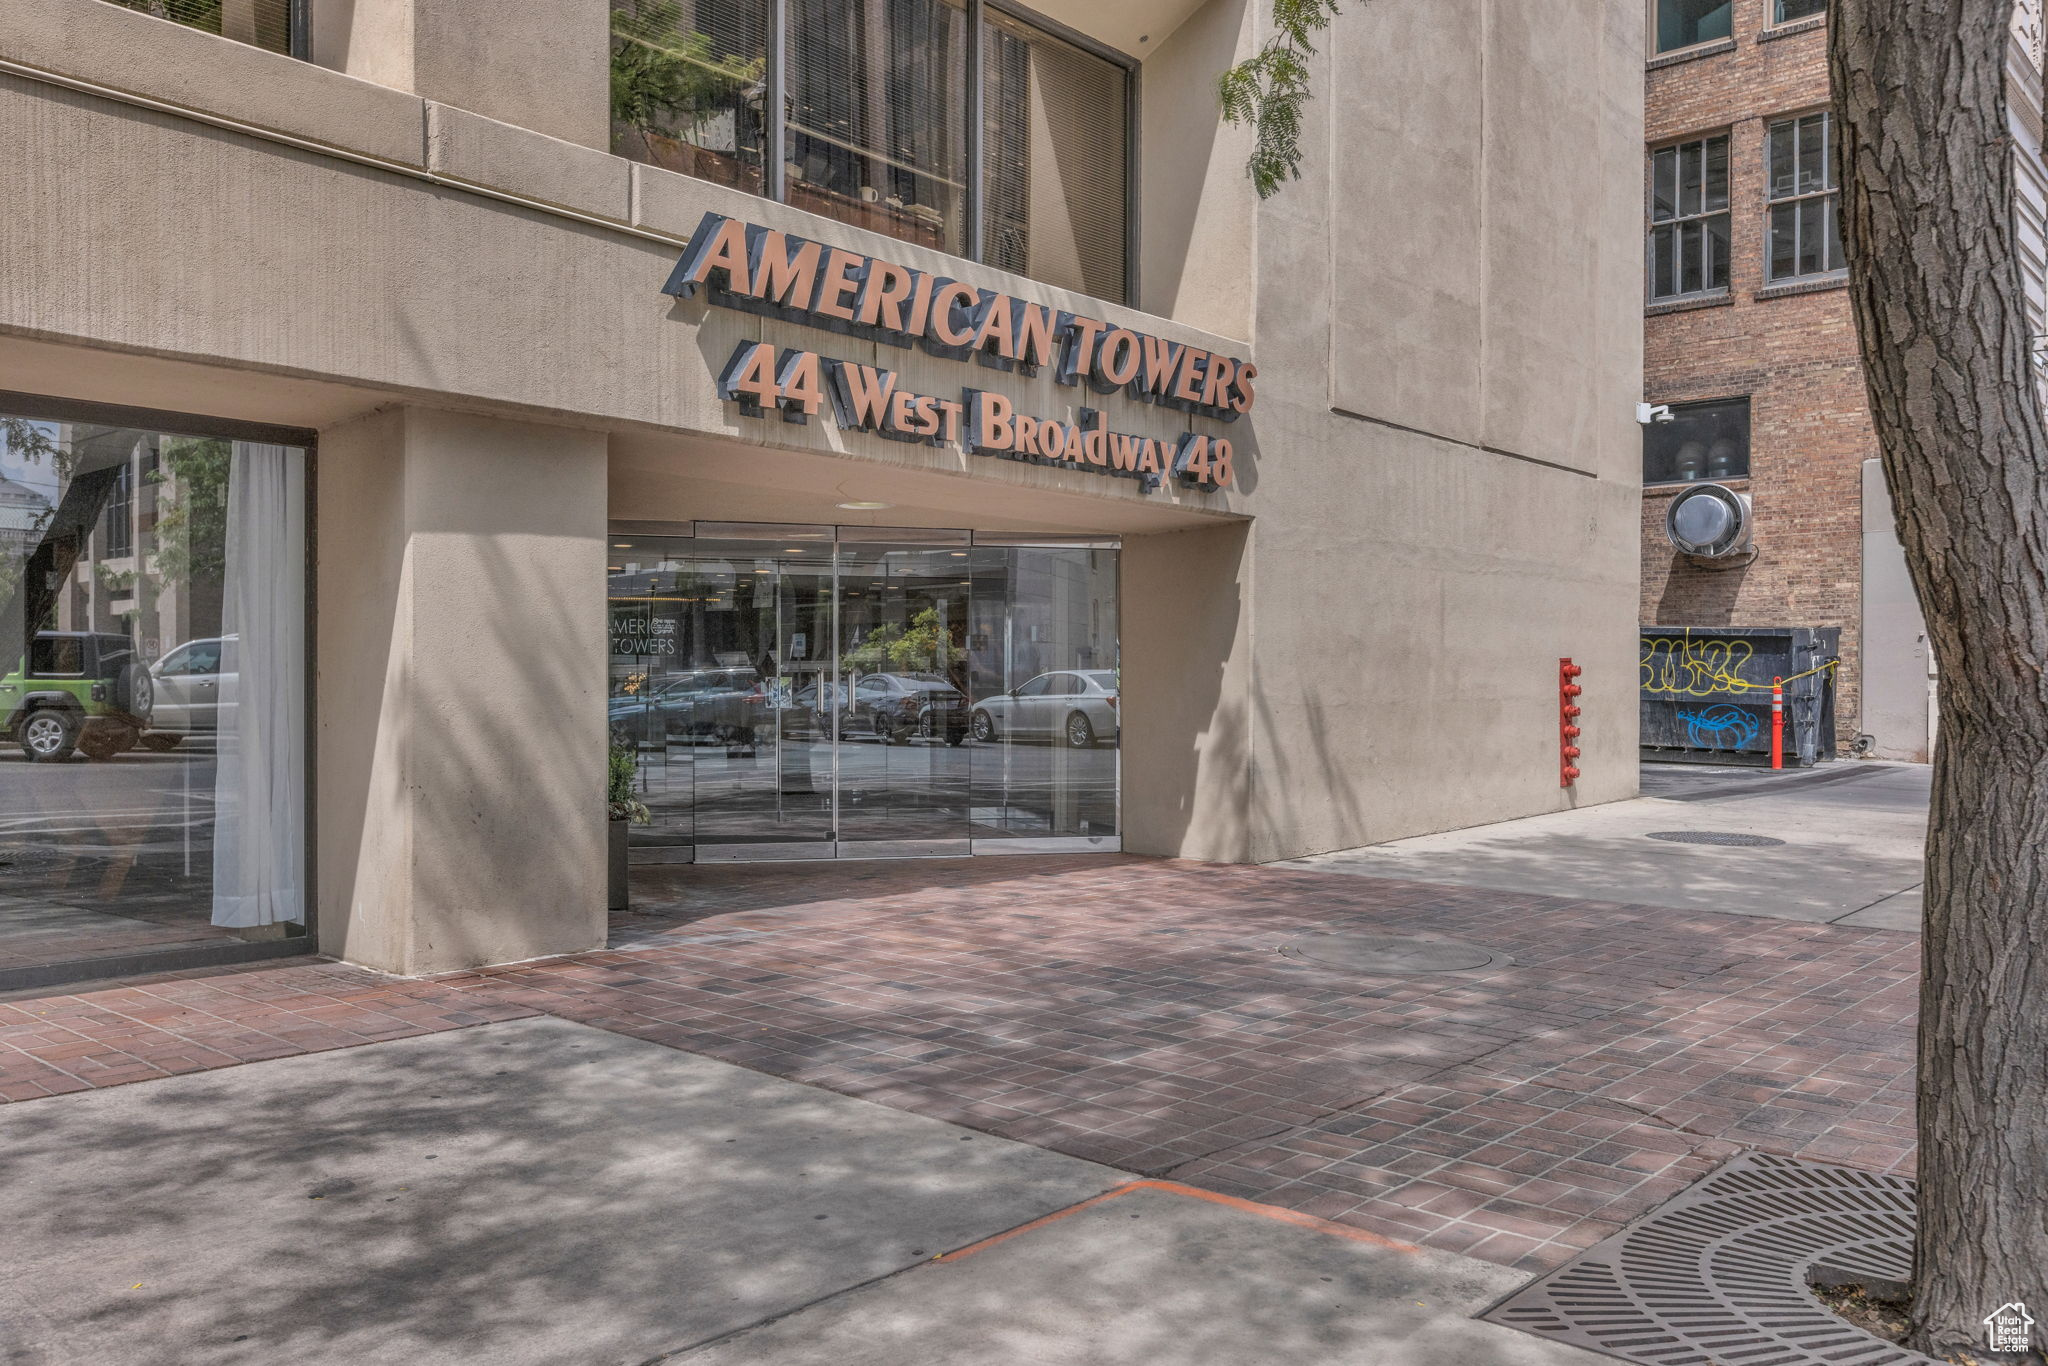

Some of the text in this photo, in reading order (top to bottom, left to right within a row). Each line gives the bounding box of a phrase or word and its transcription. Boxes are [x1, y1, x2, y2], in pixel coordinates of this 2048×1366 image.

[690, 218, 1258, 414] AMERICAN TOWERS
[732, 343, 824, 416] 44
[1184, 434, 1234, 488] 48
[613, 638, 675, 655] TOWERS
